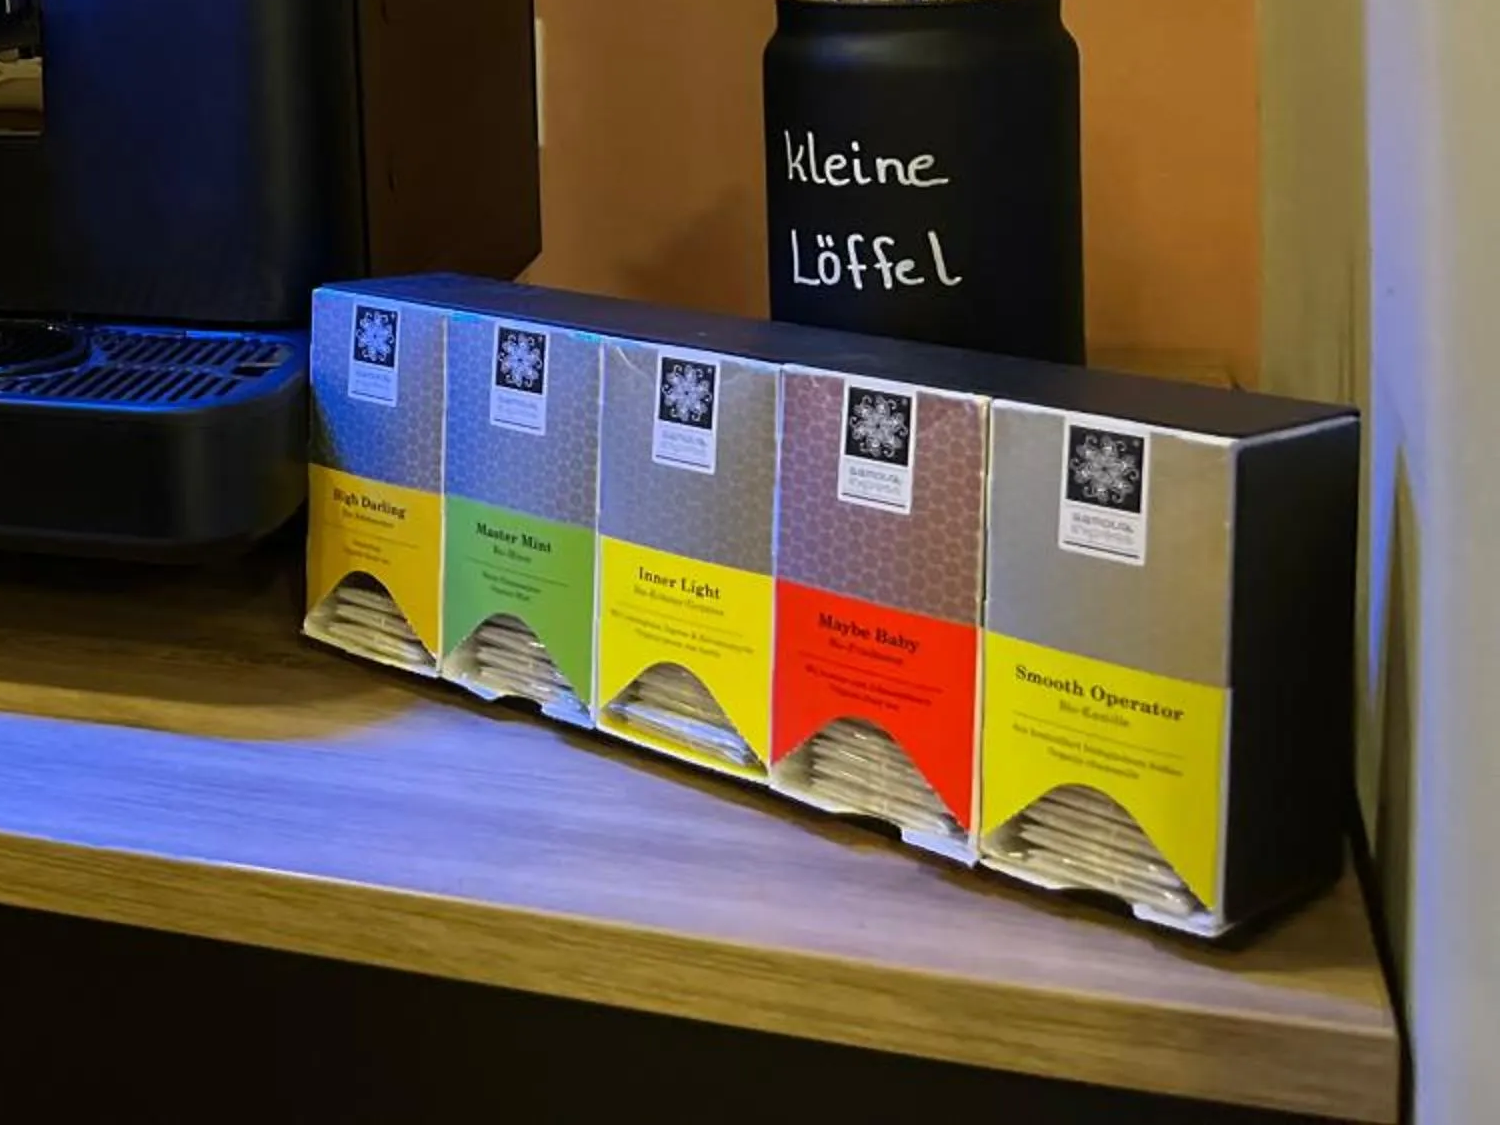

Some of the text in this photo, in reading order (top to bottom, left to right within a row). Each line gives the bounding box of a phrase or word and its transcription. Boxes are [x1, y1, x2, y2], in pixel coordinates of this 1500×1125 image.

[784, 130, 949, 187] kleine
[791, 229, 963, 290] Löffel
[361, 495, 407, 519] Darling
[476, 522, 518, 544] Master
[521, 533, 551, 554] Mint
[638, 565, 677, 588] Inner
[680, 577, 721, 600] Light
[817, 612, 871, 640] Maybe
[874, 626, 920, 654] Baby
[1015, 664, 1185, 721] Smooth Operator
